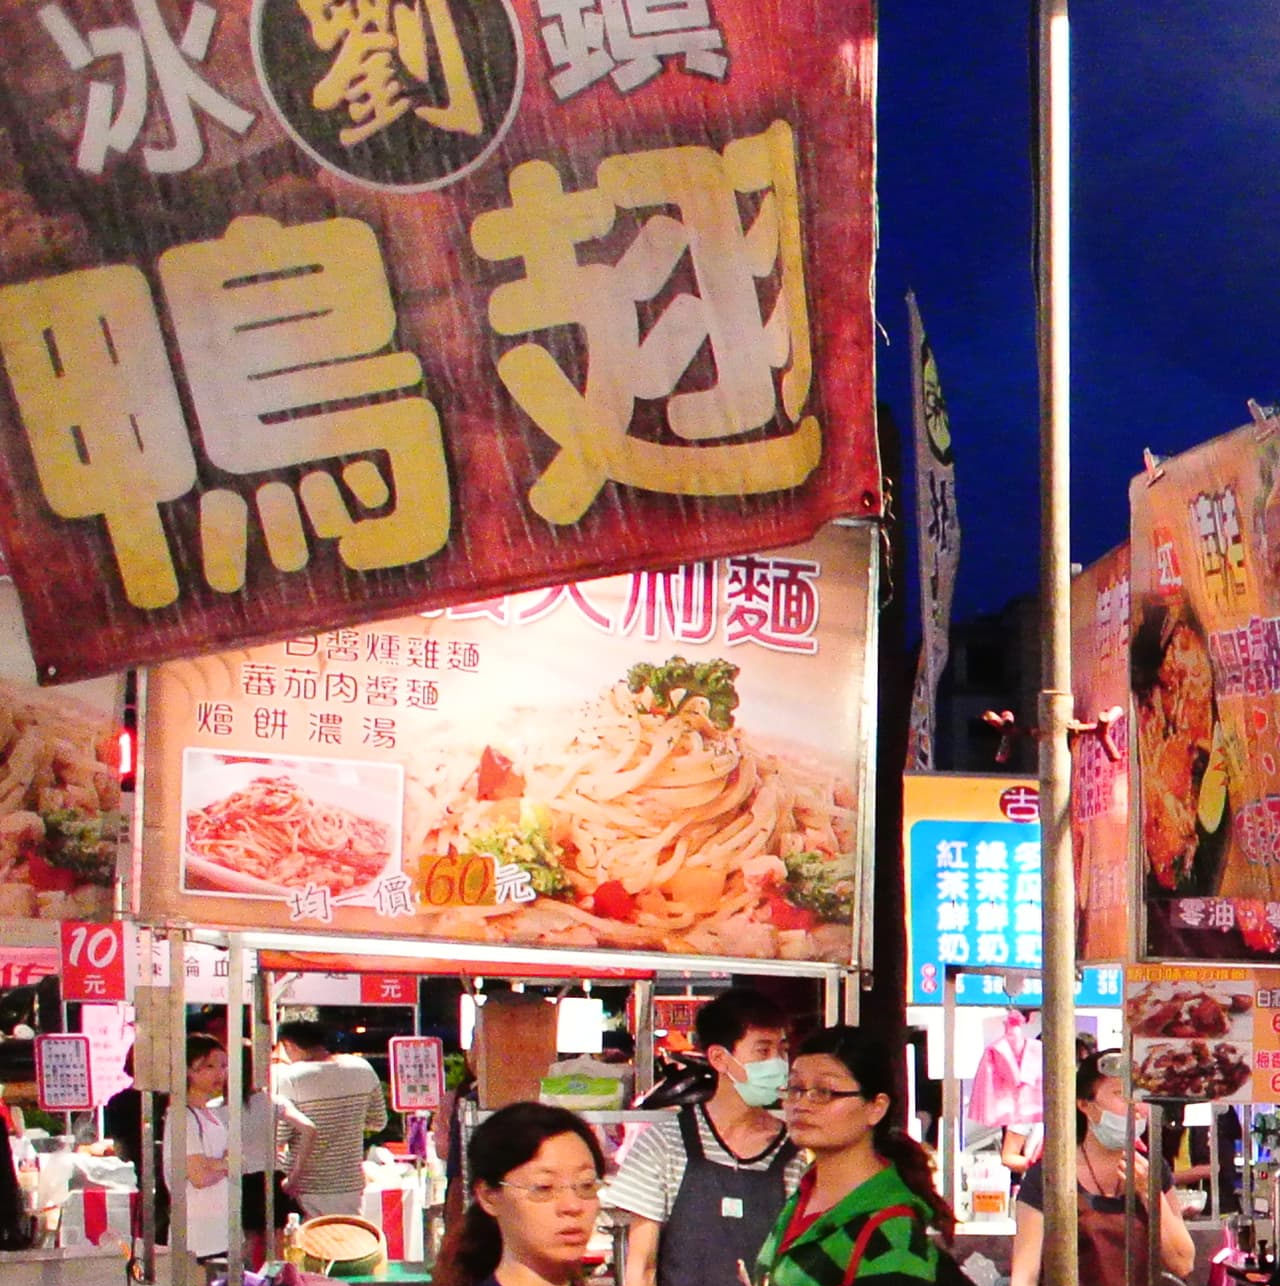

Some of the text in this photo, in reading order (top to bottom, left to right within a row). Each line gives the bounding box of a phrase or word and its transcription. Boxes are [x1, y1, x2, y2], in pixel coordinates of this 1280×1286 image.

[58, 0, 256, 176] 冰
[0, 118, 823, 611] 鴨翅
[242, 662, 440, 712] 蕃茄肉醬麵
[196, 701, 399, 750] 燴餅濃湯
[935, 839, 970, 963] 紅茶鮮奶
[68, 925, 119, 968] 10
[83, 974, 107, 995] 元
[380, 980, 403, 999] 元
